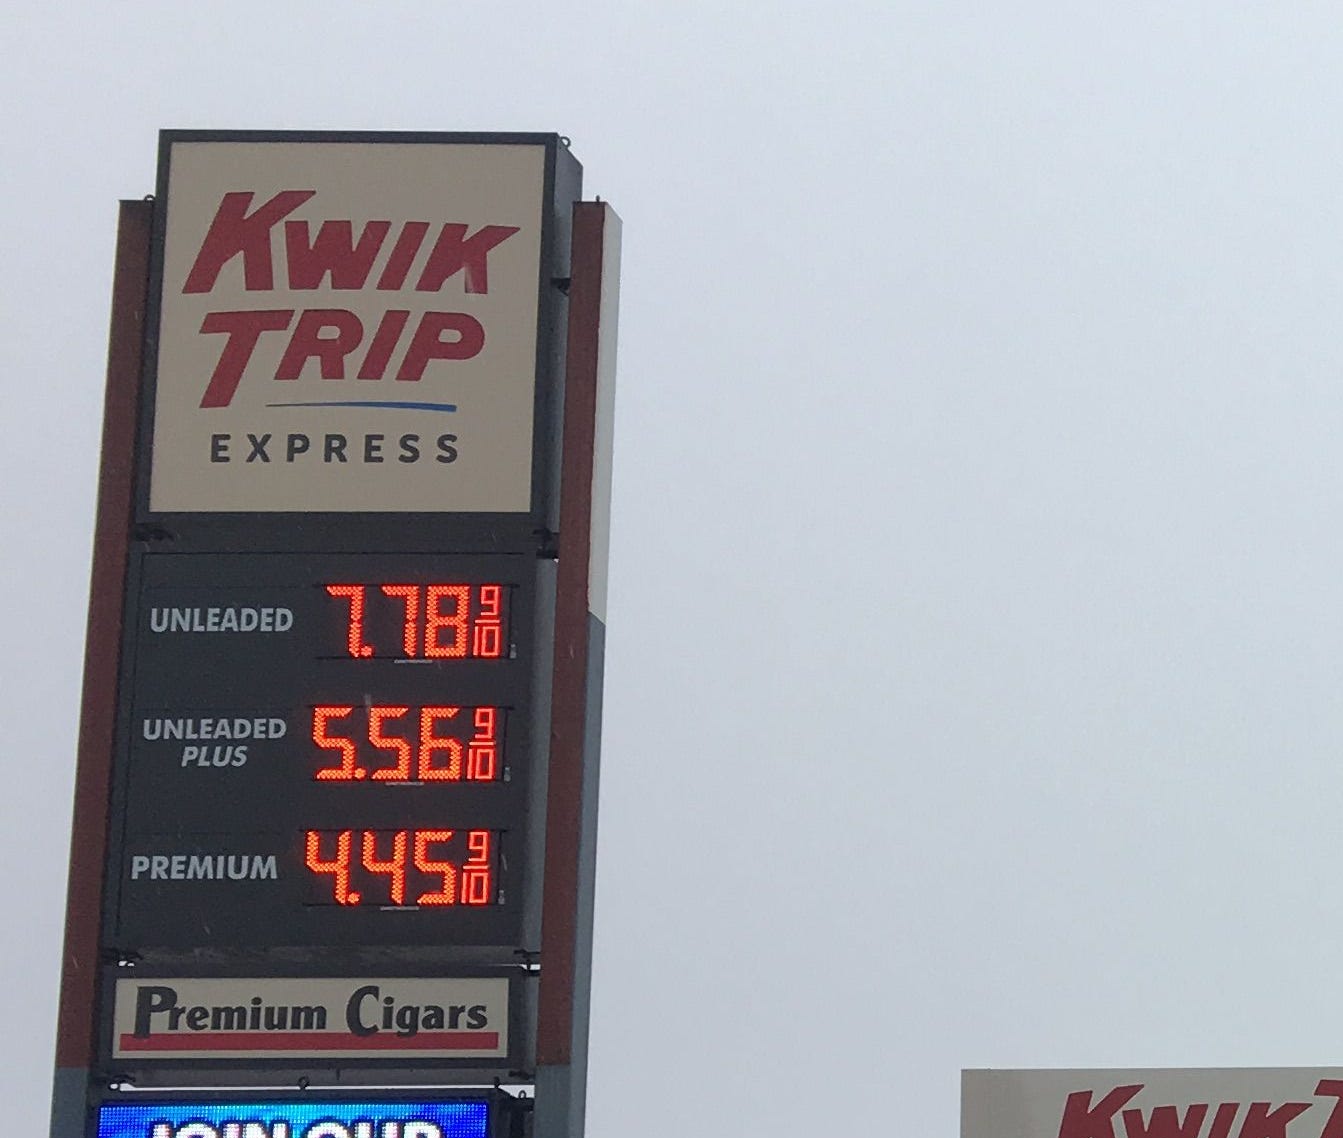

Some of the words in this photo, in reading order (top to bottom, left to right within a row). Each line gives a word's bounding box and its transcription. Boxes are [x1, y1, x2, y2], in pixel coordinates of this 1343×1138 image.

[182, 190, 521, 294] KWIK
[199, 309, 485, 408] TRIP
[211, 434, 458, 462] EXPRESS
[480, 585, 502, 616] 9
[151, 608, 293, 632] UNLEADED
[326, 584, 471, 658] 7.78
[473, 624, 501, 657] 10
[474, 707, 496, 738] 9
[143, 718, 287, 741] UNLEADED
[311, 706, 462, 780] 5.56
[181, 744, 248, 768] PLUS
[467, 748, 496, 780] 10
[468, 831, 490, 861] 9
[131, 855, 278, 880] PREMIUM
[305, 830, 456, 904] 4.45
[461, 871, 490, 904] 10
[134, 985, 327, 1038] Premium
[346, 985, 488, 1036] Cigars
